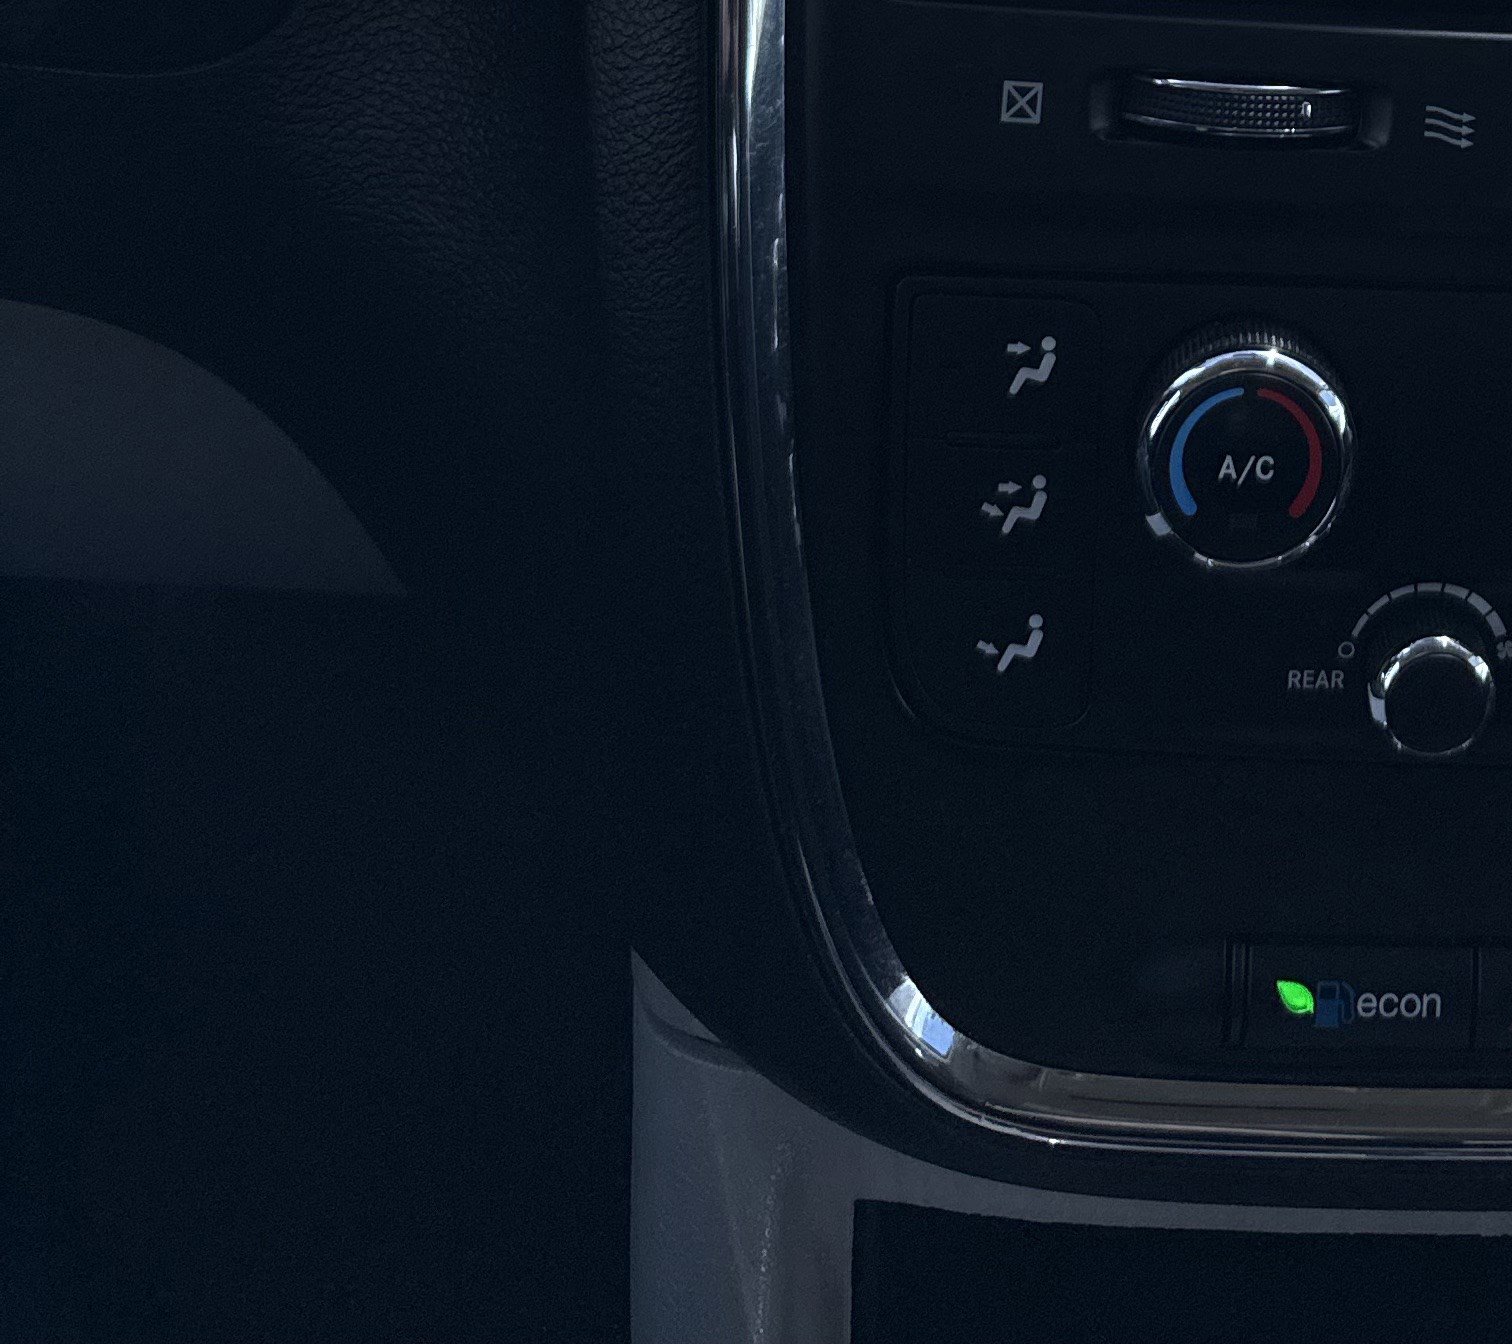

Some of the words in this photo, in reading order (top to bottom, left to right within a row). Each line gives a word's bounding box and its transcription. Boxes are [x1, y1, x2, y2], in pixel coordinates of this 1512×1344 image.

[1218, 454, 1275, 486] A/C
[1287, 669, 1345, 690] REAR
[1356, 992, 1442, 1018] econ
